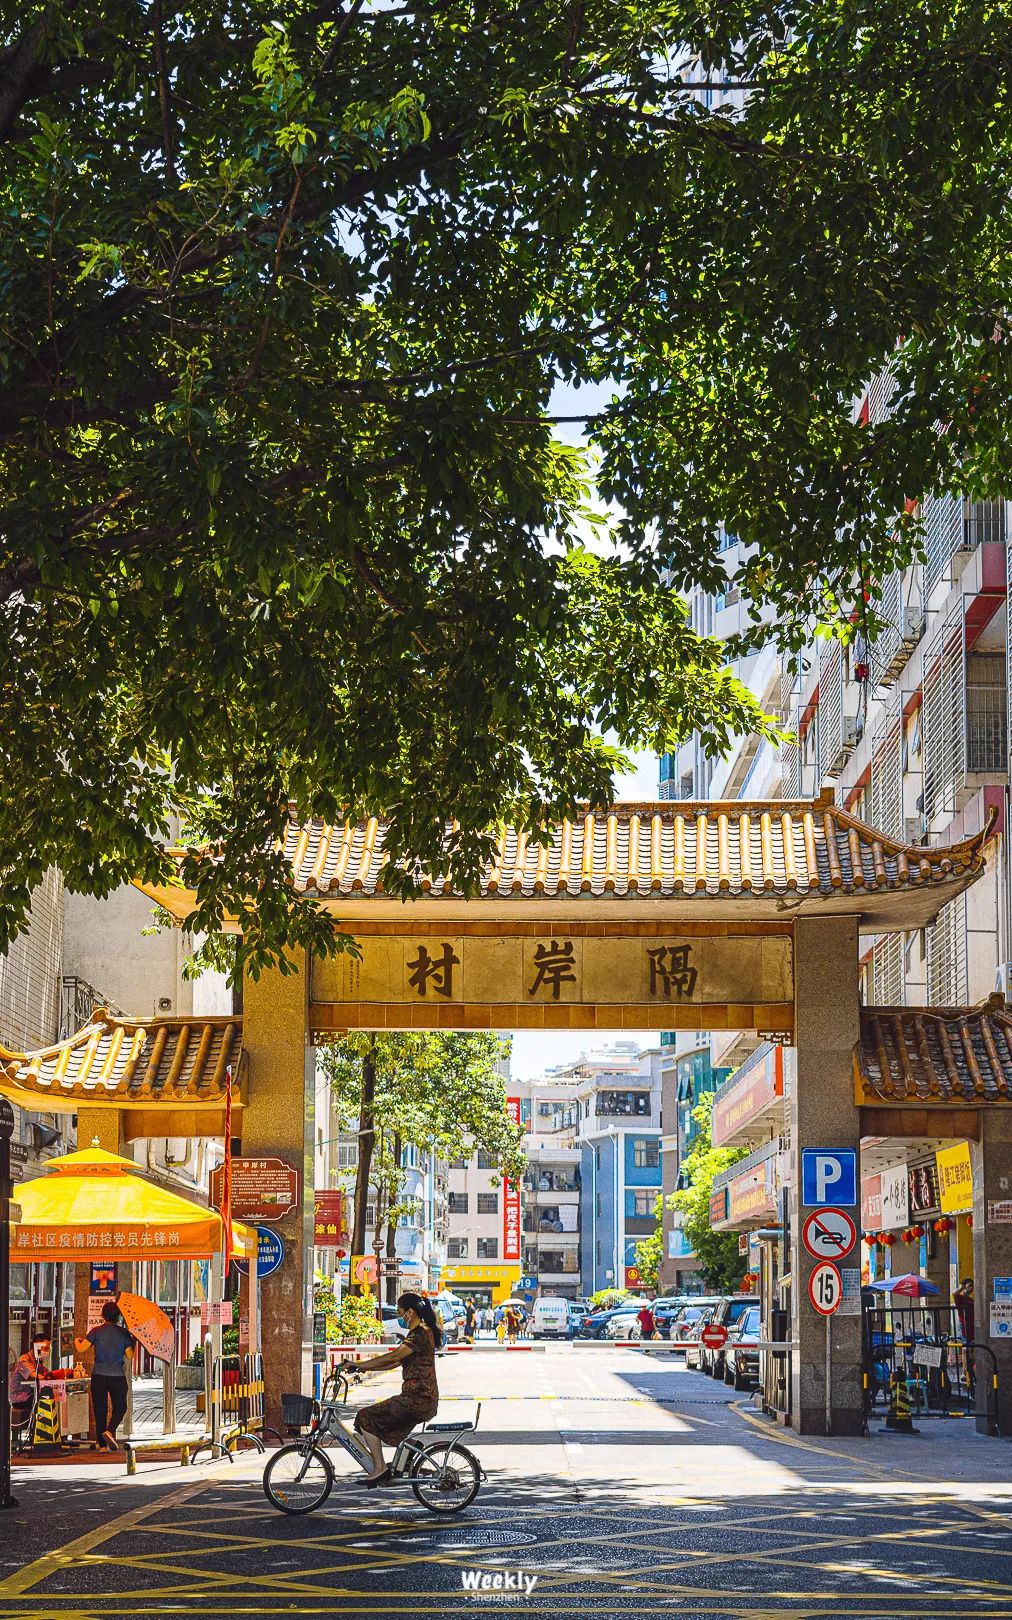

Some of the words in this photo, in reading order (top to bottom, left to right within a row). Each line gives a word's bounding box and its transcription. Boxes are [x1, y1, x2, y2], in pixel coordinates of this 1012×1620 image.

[816, 1157, 842, 1202] P
[9, 1231, 180, 1248] 岸社区疫情防控党员先锋岗
[817, 1272, 834, 1304] 15
